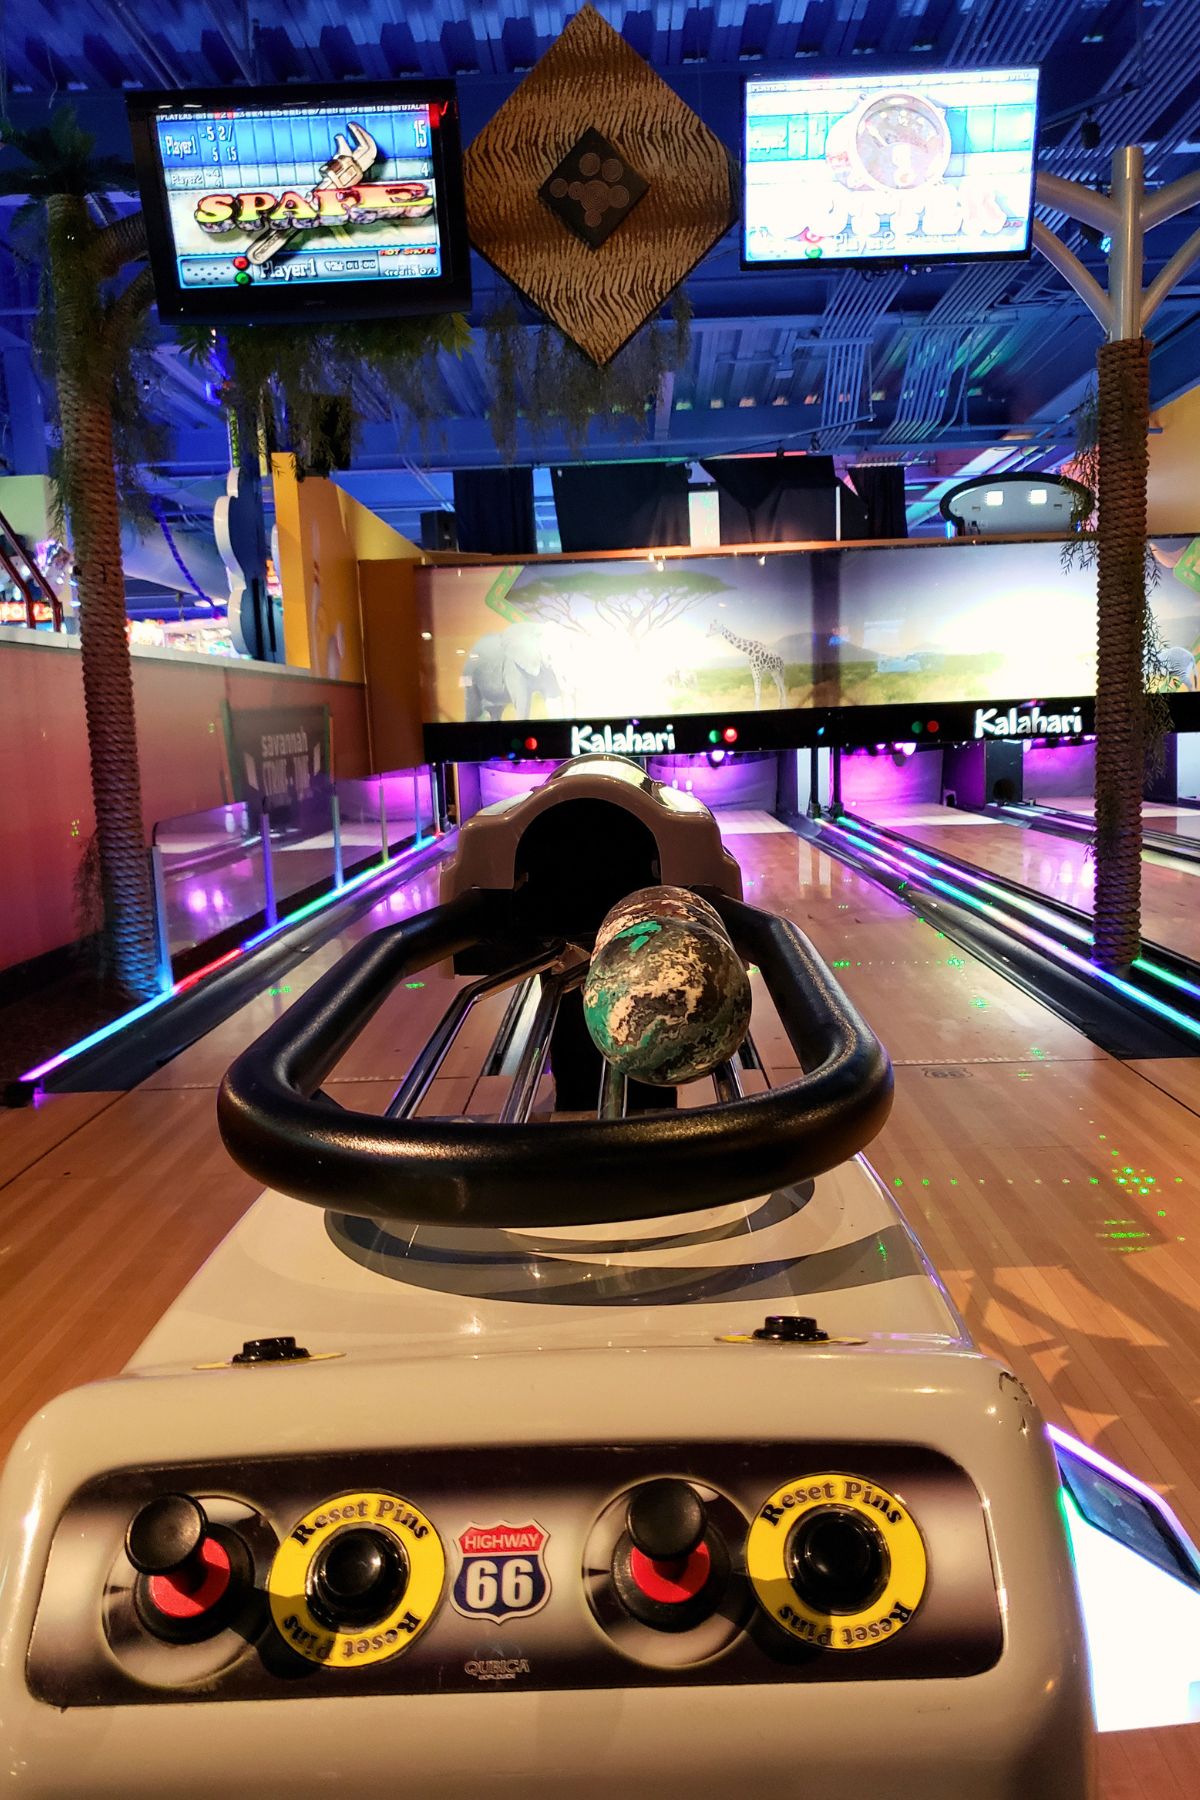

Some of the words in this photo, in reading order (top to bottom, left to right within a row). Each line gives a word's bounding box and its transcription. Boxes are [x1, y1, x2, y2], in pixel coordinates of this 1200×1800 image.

[165, 135, 197, 159] Player1
[414, 120, 428, 148] 15
[212, 147, 219, 162] 5
[226, 146, 237, 161] 15
[421, 162, 429, 177] 4
[259, 257, 318, 281] Player1
[570, 724, 676, 755] Kalahari
[974, 706, 1082, 739] Kalahari
[290, 1499, 368, 1546] Reset
[375, 1498, 429, 1540] Pins
[760, 1481, 835, 1526] Reset
[844, 1480, 902, 1524] Pins
[464, 1533, 539, 1549] HIGHWAY
[465, 1559, 535, 1609] 66
[283, 1614, 332, 1660] Pins
[342, 1611, 422, 1657] Reset
[778, 1605, 834, 1646] Pins
[843, 1601, 912, 1645] Reset
